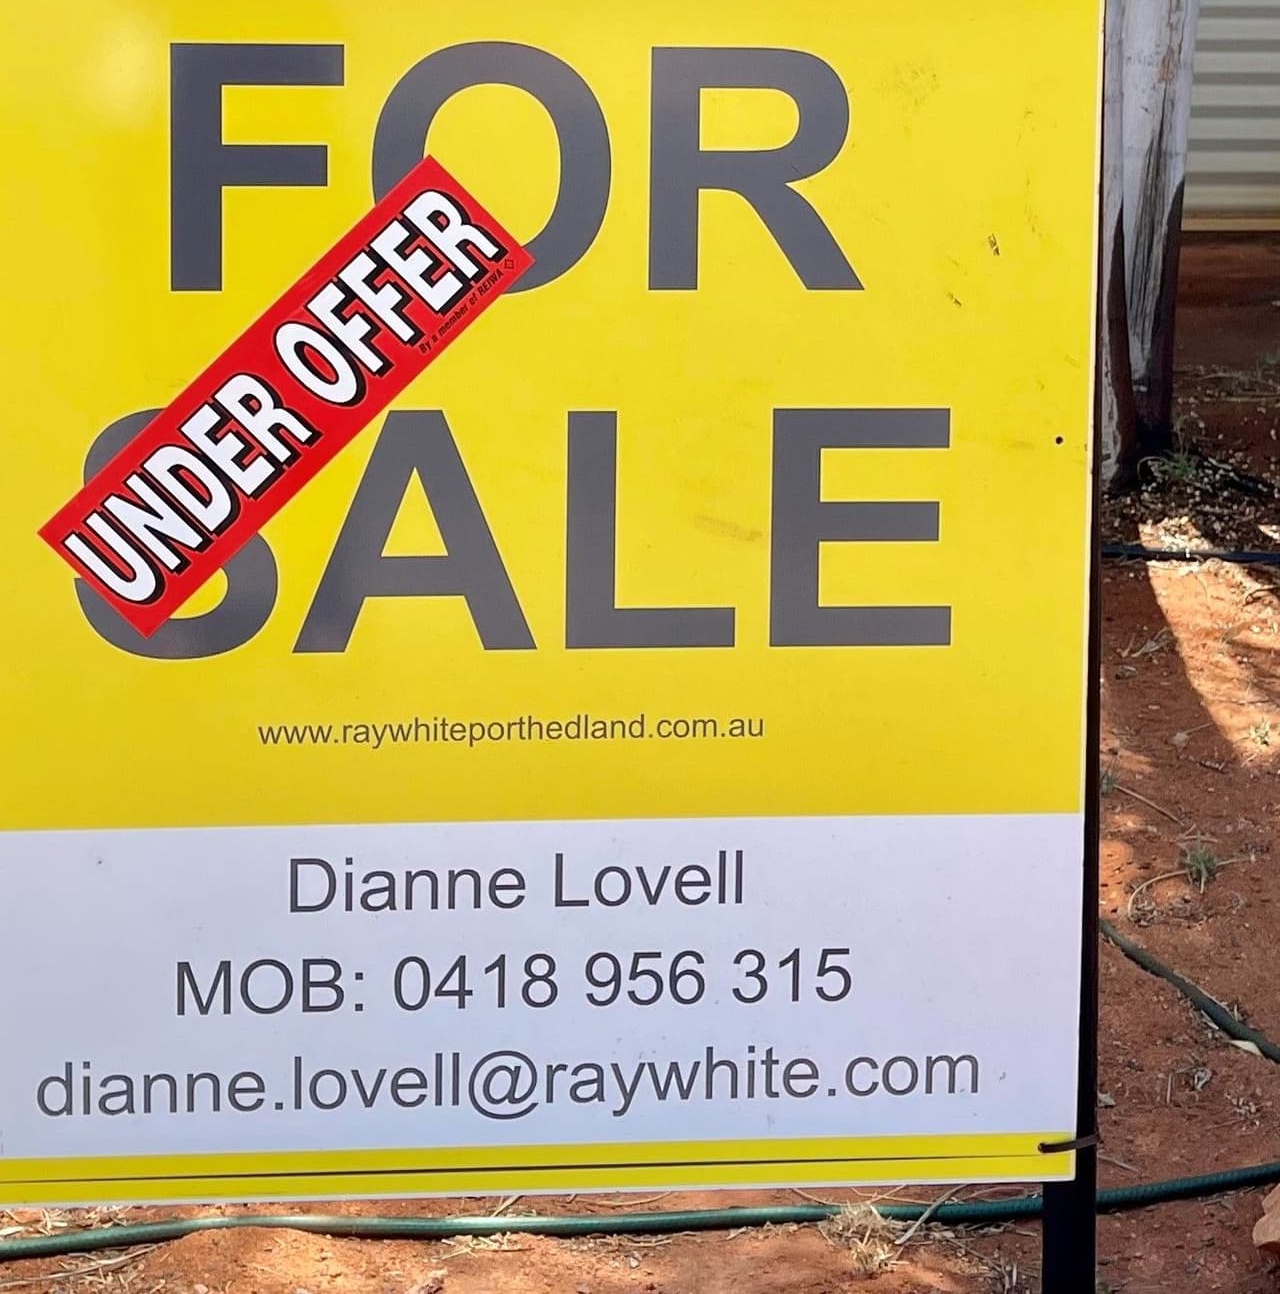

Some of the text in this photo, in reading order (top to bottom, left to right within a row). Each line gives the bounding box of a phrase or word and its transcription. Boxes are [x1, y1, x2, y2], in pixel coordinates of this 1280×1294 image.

[169, 40, 866, 295] FOR
[63, 188, 508, 605] UNDER OFFER
[257, 713, 765, 751] www.raywhiteporthedland.com.au
[289, 849, 745, 914] Dianne Lovell
[176, 947, 853, 1017] MOB: 0418 956 315
[35, 1044, 980, 1121] dianne.lovell@raywhite.com
